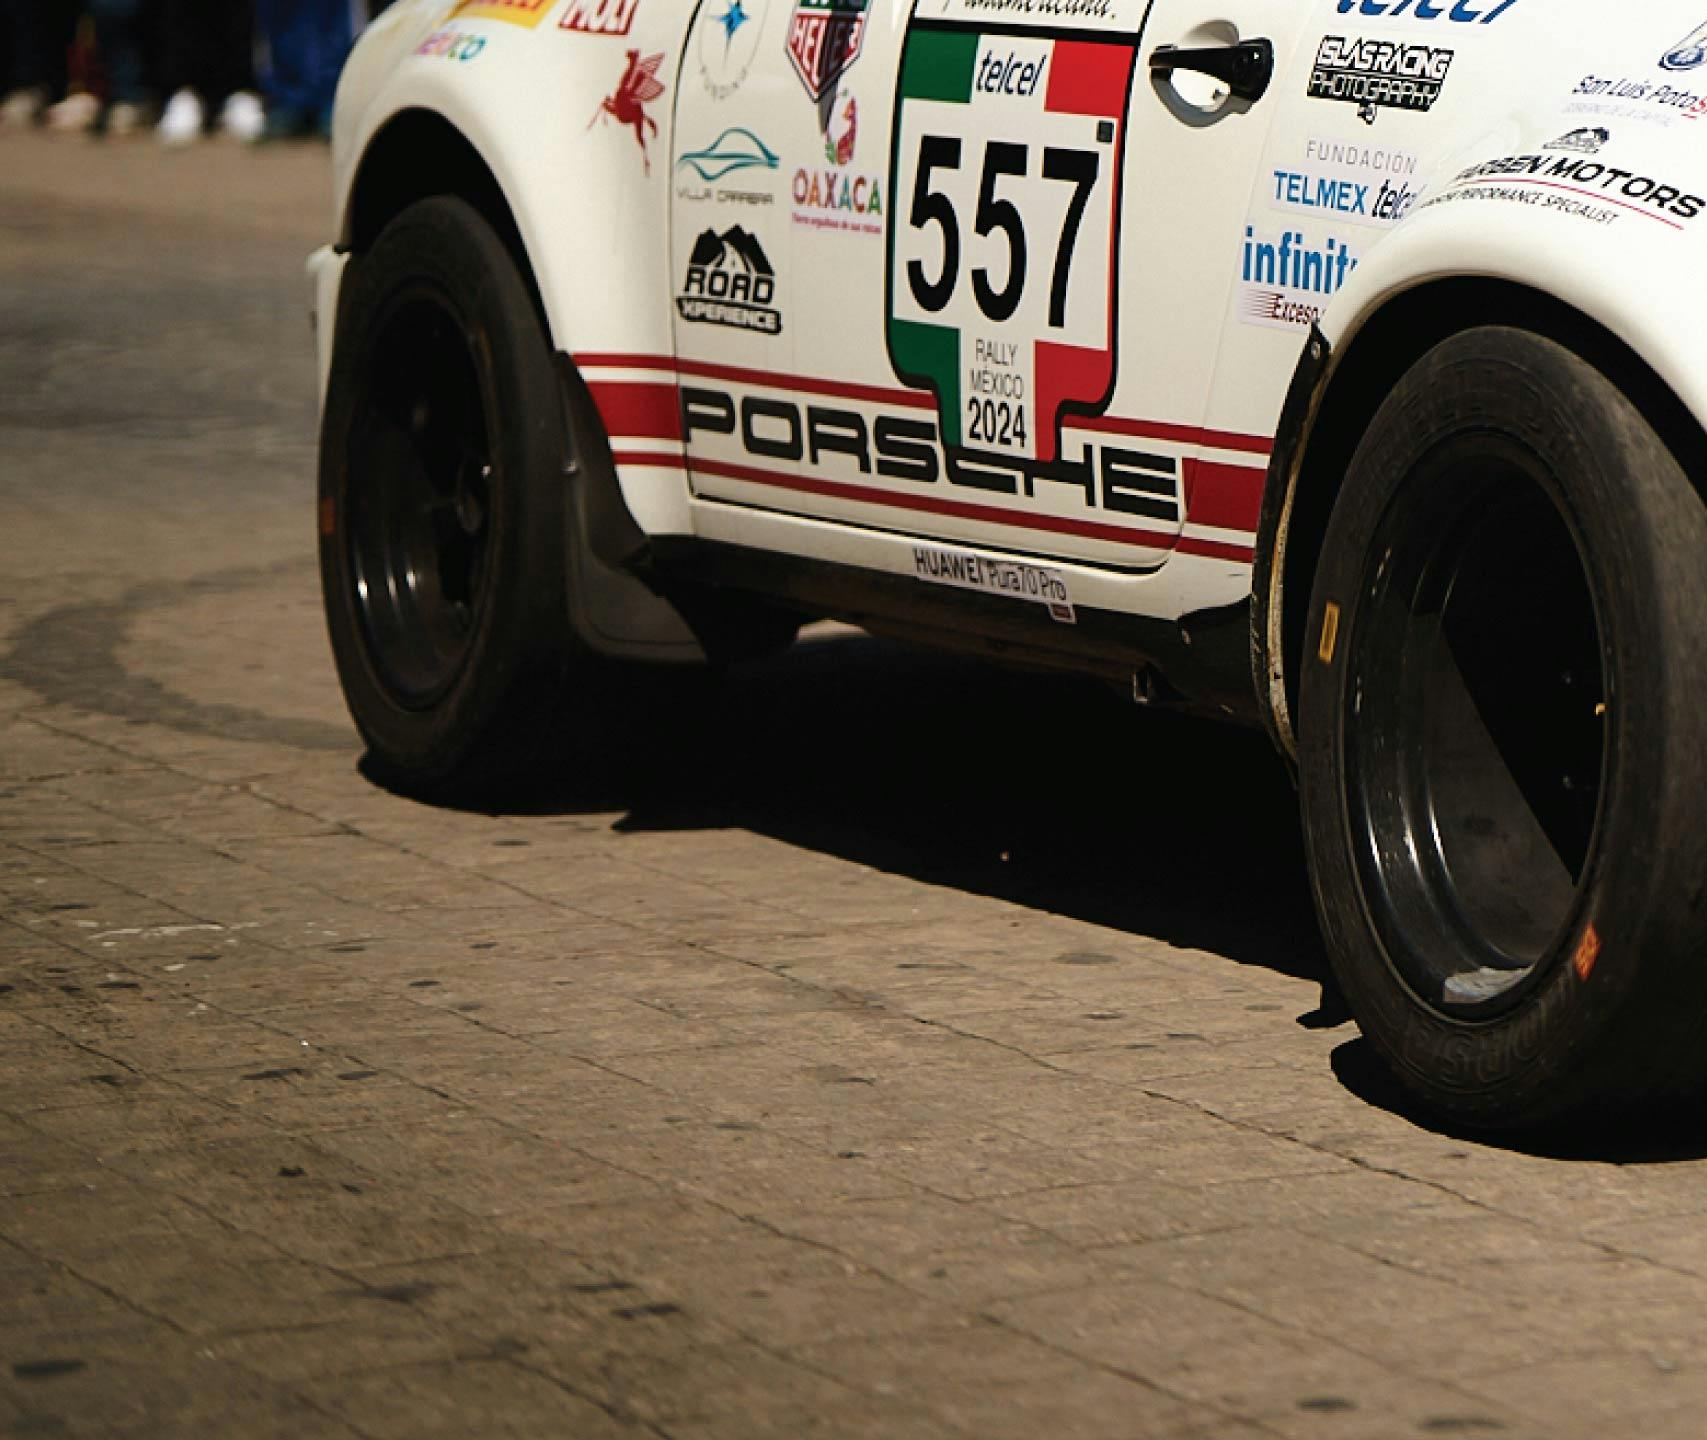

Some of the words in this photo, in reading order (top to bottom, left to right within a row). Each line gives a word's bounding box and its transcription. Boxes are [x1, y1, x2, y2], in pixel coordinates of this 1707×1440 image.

[790, 15, 863, 95] HEUER
[976, 49, 1048, 96] telcel
[1308, 71, 1440, 111] PHOTOGRAPHY
[1572, 74, 1613, 95] San
[793, 168, 884, 216] OAXACA
[1274, 171, 1369, 215] TELMEX
[1540, 195, 1620, 225] SPECIALIST
[1545, 158, 1706, 218] MOTORS
[907, 134, 1100, 329] 557
[1243, 224, 1358, 295] infinit
[684, 266, 775, 305] ROAD
[680, 299, 780, 333] XPERIENCE
[975, 339, 1019, 367] RALLY
[969, 364, 1024, 400] MÉXICO
[968, 397, 1027, 449] 2024
[680, 386, 1180, 522] PORSCHE
[913, 547, 984, 584] HUAWEI
